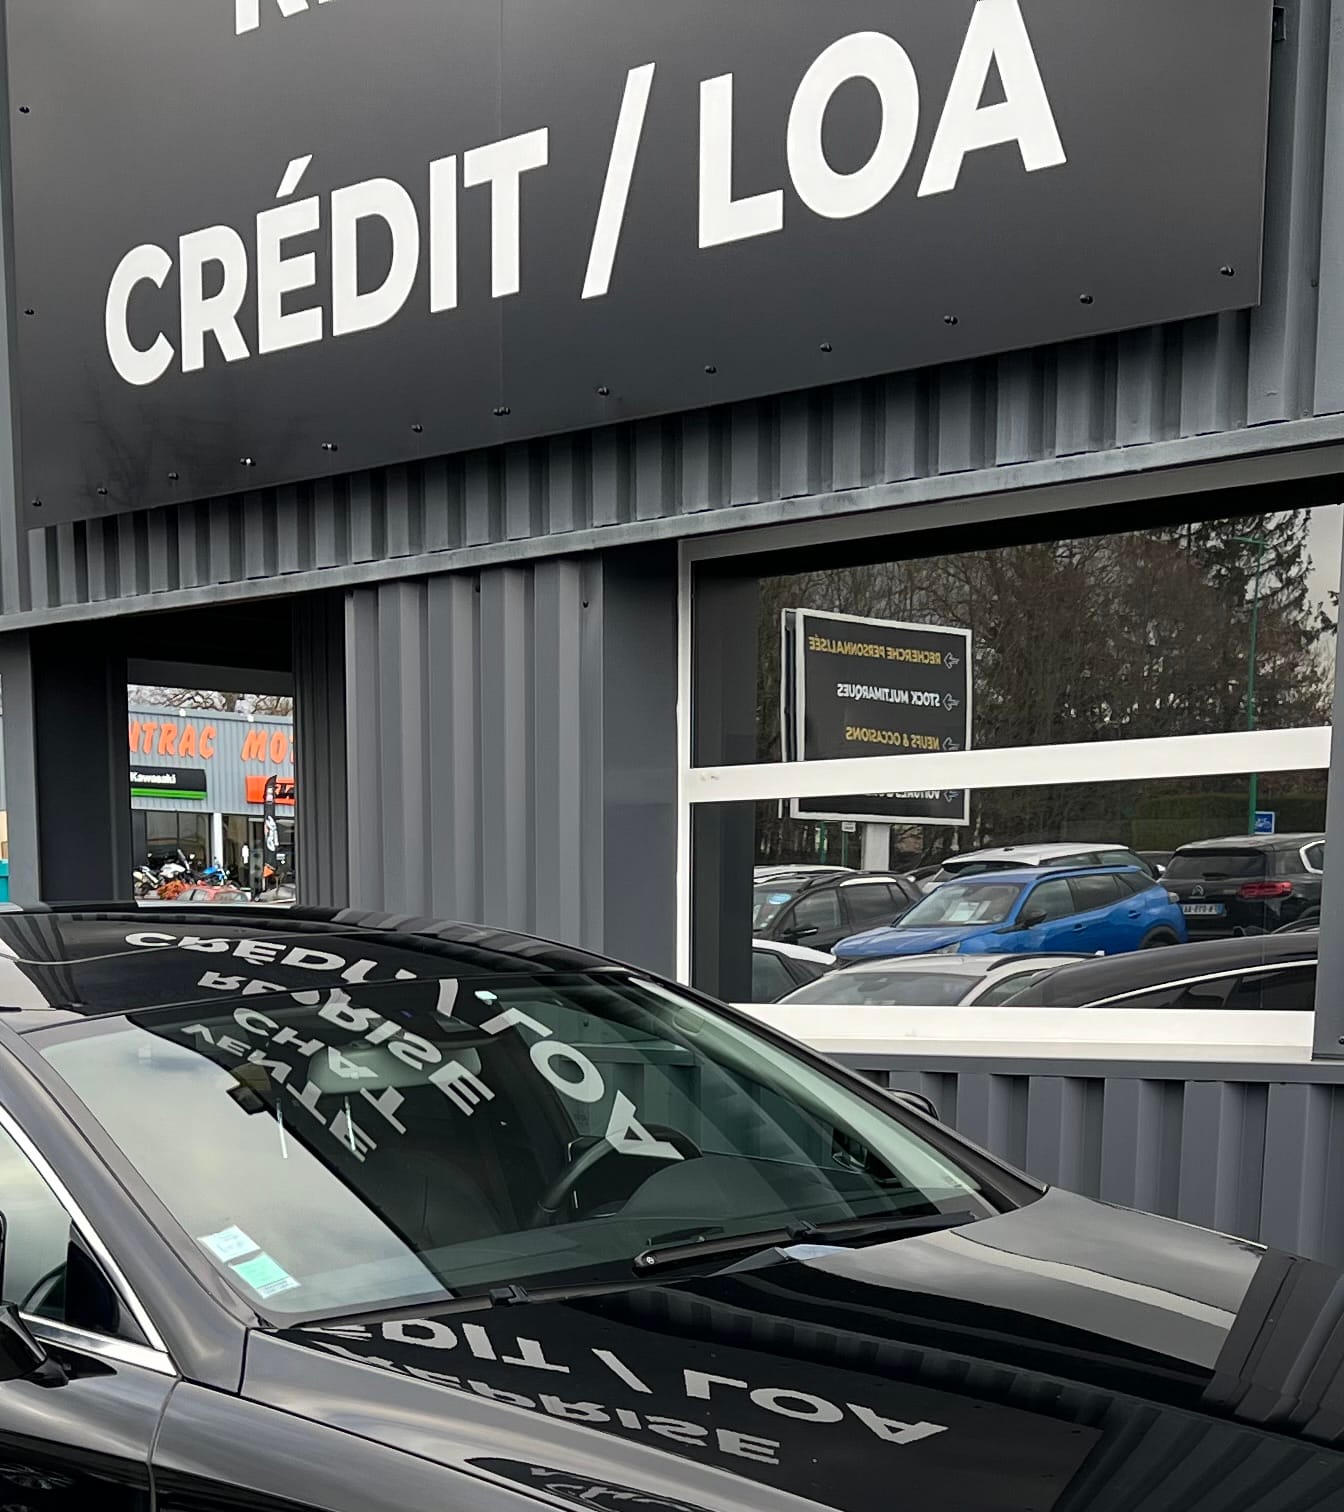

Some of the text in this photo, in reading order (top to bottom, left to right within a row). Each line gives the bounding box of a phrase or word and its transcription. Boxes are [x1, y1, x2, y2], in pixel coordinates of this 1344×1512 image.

[106, 0, 1066, 384] CRÉDIT / LOA
[241, 728, 294, 764] MO
